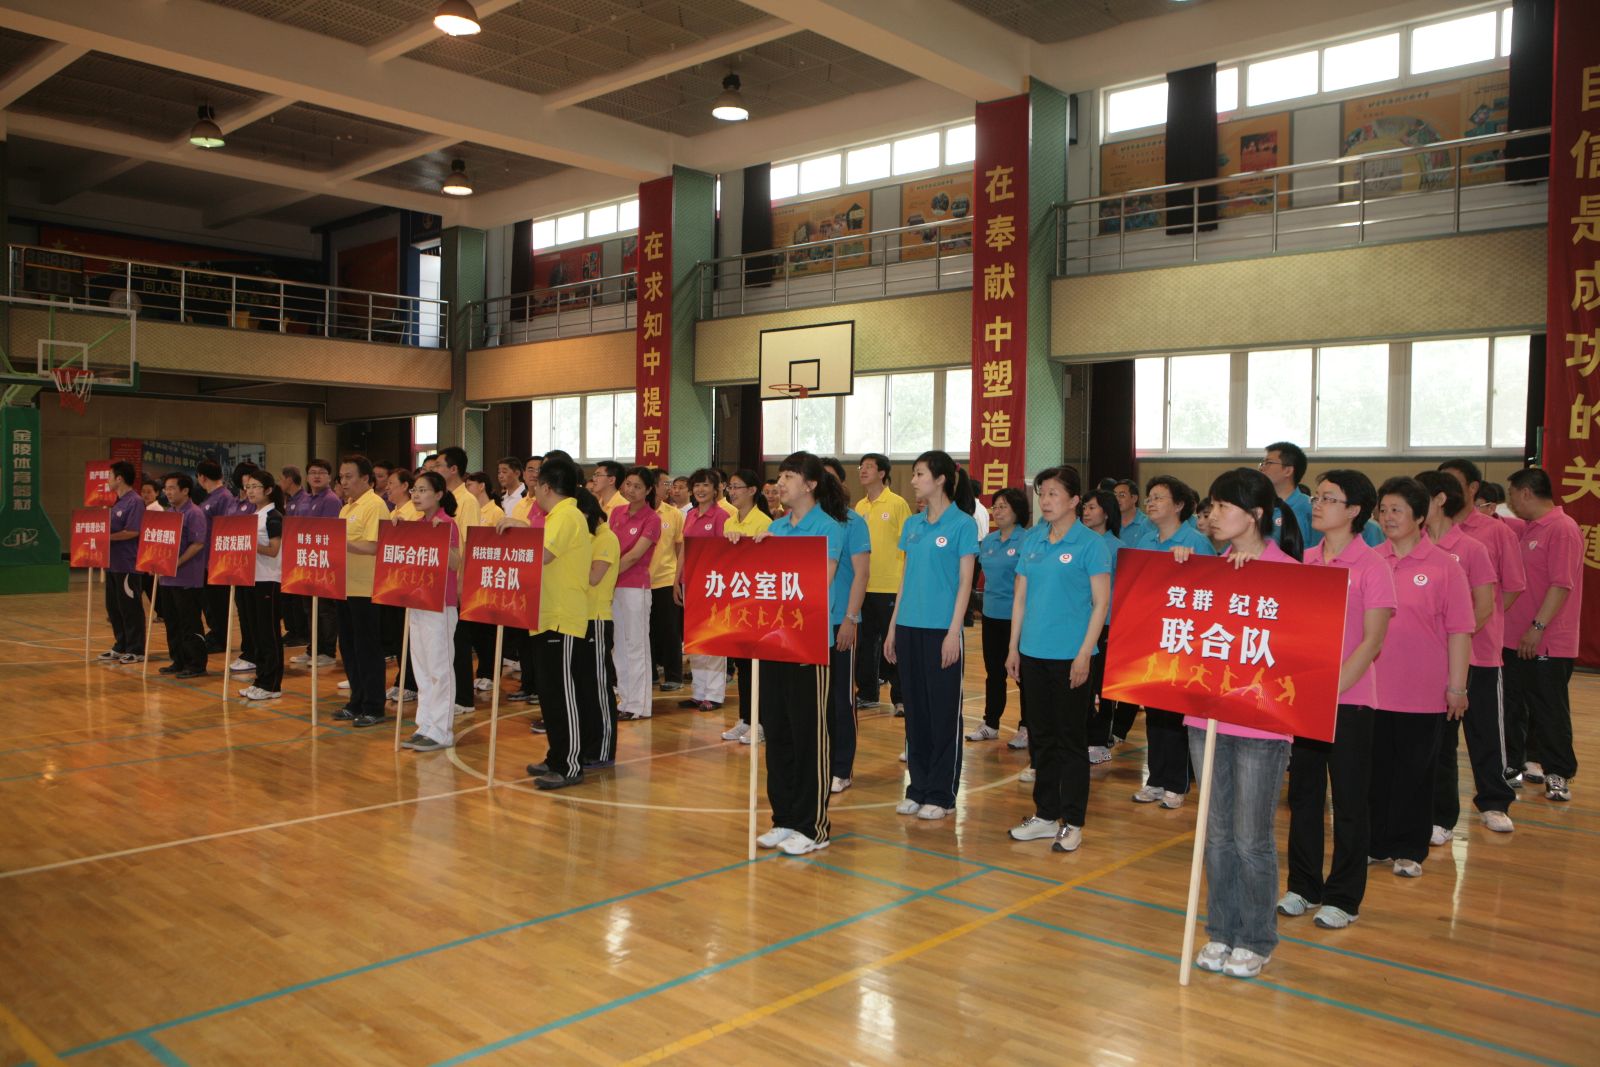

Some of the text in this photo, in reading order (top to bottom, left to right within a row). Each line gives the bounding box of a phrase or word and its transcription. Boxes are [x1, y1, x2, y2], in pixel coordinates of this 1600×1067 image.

[642, 231, 664, 470] 在求知中提高
[981, 165, 1015, 527] 在奉献中塑造自
[82, 537, 97, 551] 一队
[143, 528, 176, 545] 企业管理队
[215, 535, 252, 552] 投资发展队
[297, 533, 330, 546] 财务 审计
[296, 549, 330, 569] 联合队
[383, 544, 440, 567] 国际合作队
[472, 546, 535, 563] 科技管理 人力资源
[480, 566, 520, 590] 联合队
[704, 570, 805, 602] 办公室队
[1166, 585, 1280, 621] 党群 纪检
[1159, 617, 1276, 668] 联合队
